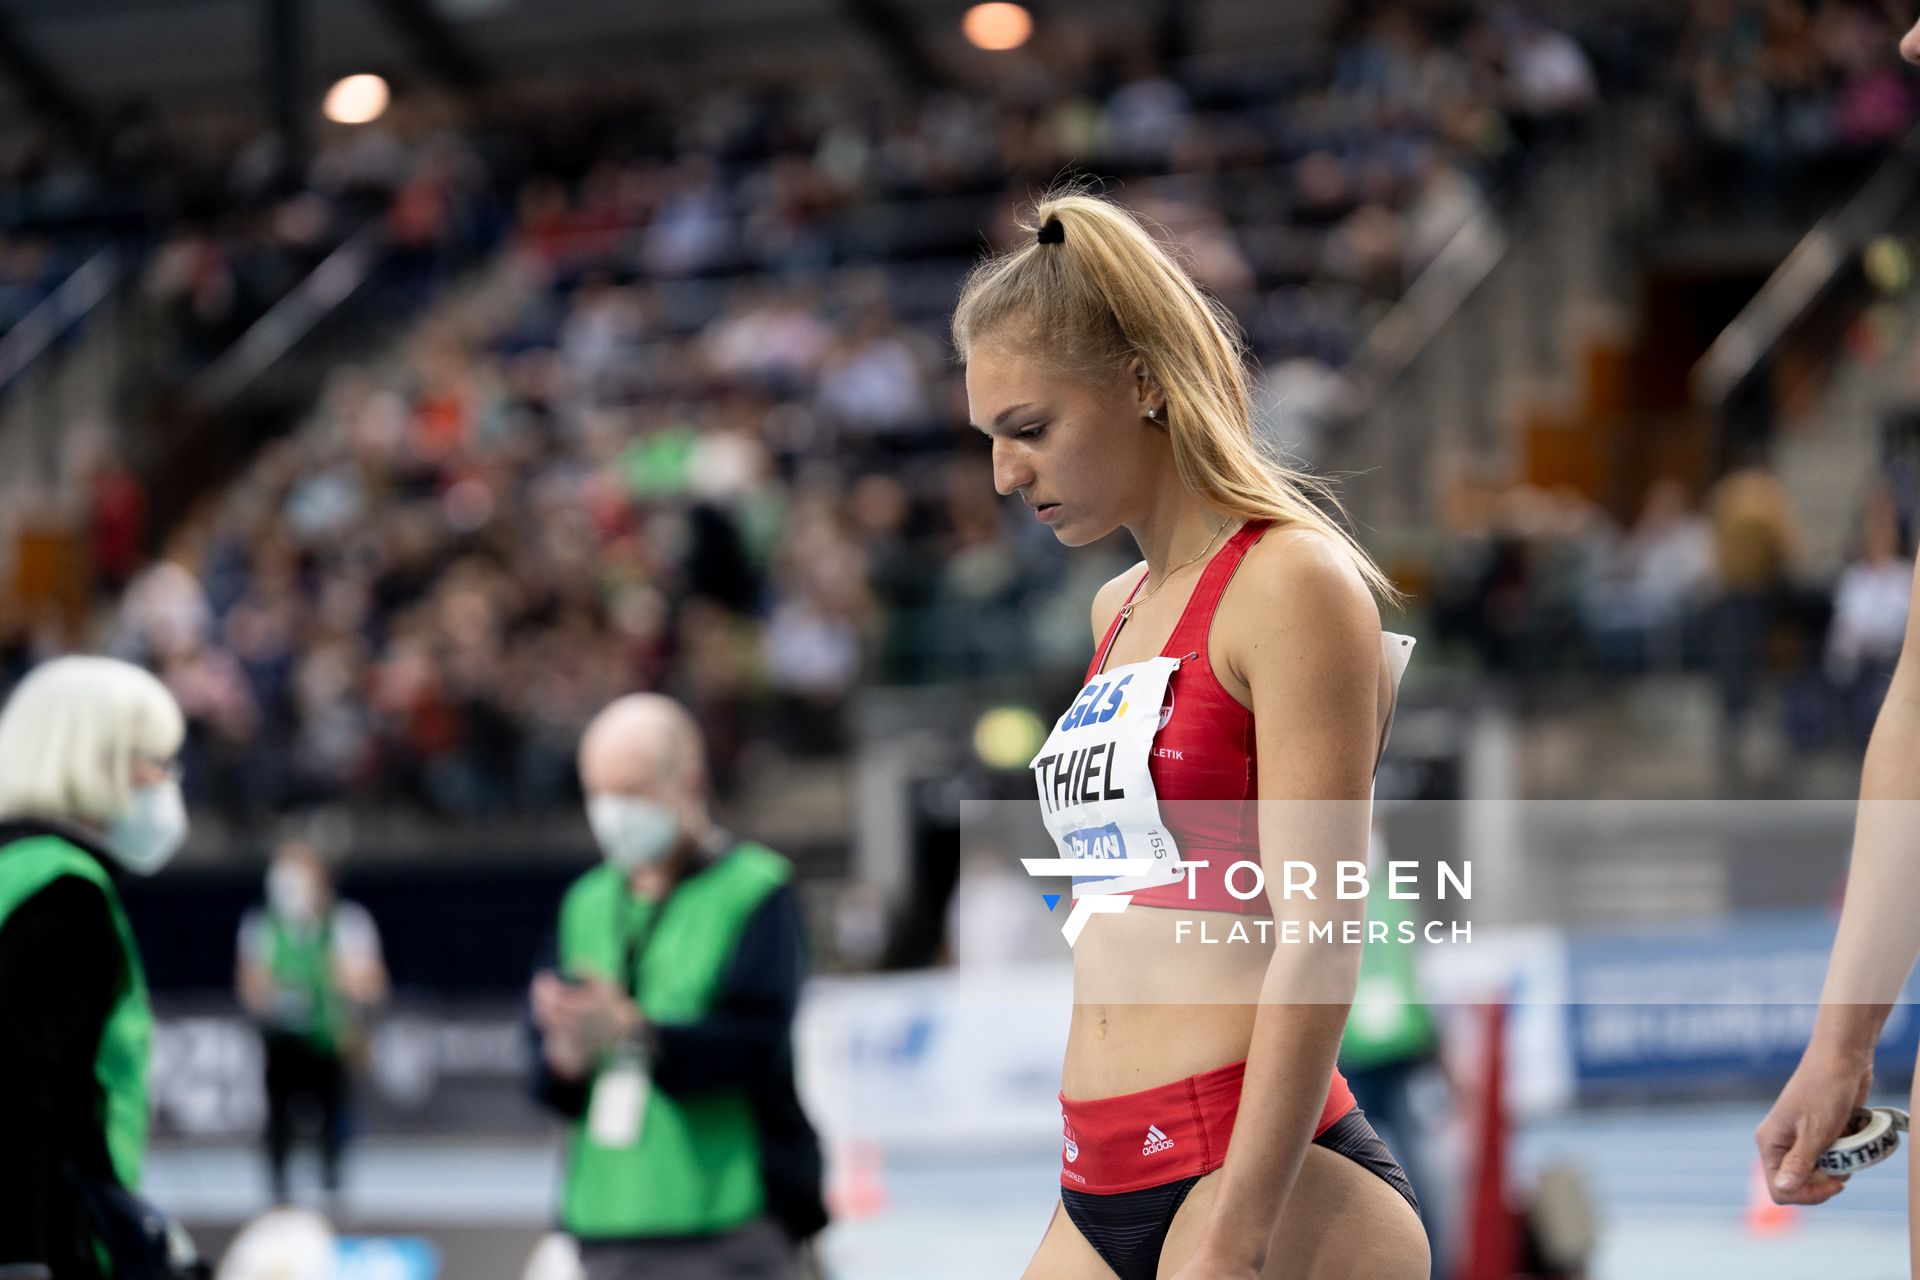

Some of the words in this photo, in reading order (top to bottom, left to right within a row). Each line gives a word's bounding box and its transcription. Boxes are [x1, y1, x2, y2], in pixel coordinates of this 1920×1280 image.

[1150, 747, 1184, 760] LETIK
[1037, 741, 1125, 814] THIEL
[1147, 829, 1168, 860] 155
[1142, 1138, 1175, 1156] adidas
